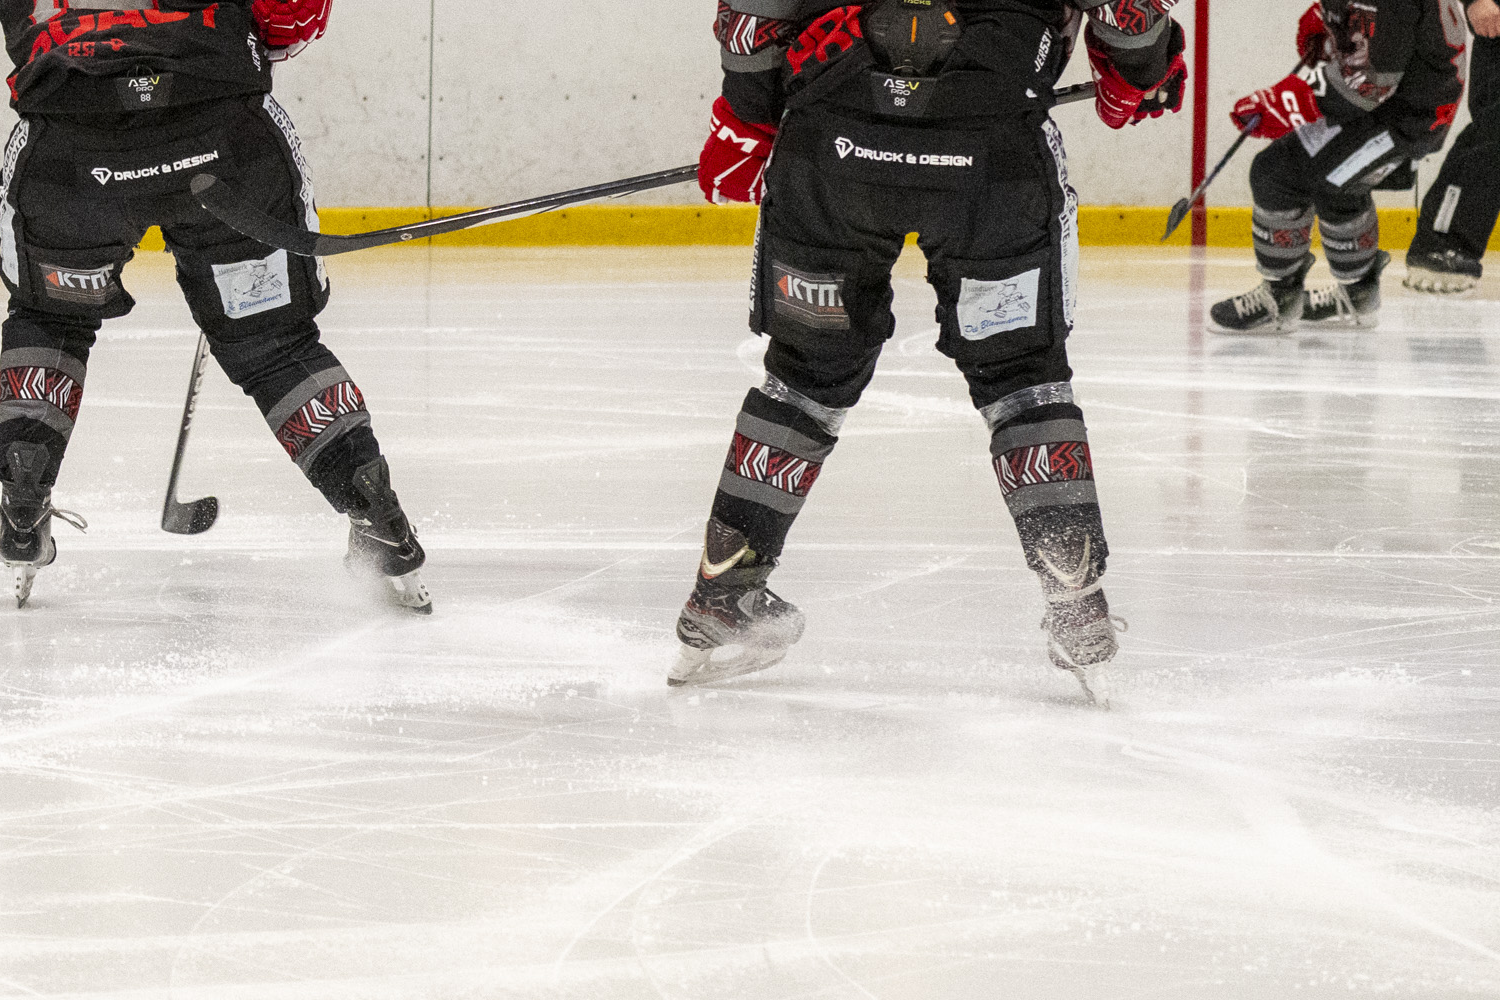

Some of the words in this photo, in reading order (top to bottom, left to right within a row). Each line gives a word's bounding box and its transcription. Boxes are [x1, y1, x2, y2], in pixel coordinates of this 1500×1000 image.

[128, 76, 160, 87] AS-V
[883, 78, 920, 90] AS-V
[140, 93, 151, 101] 88
[890, 88, 911, 96] PRO
[893, 97, 906, 107] 88
[854, 146, 903, 163] DRUCK
[905, 153, 917, 164] &
[919, 154, 973, 167] DESIGN
[113, 166, 160, 181] DRUCK
[161, 164, 172, 173] &
[173, 150, 219, 171] DESIGN
[787, 275, 844, 307] KTM
